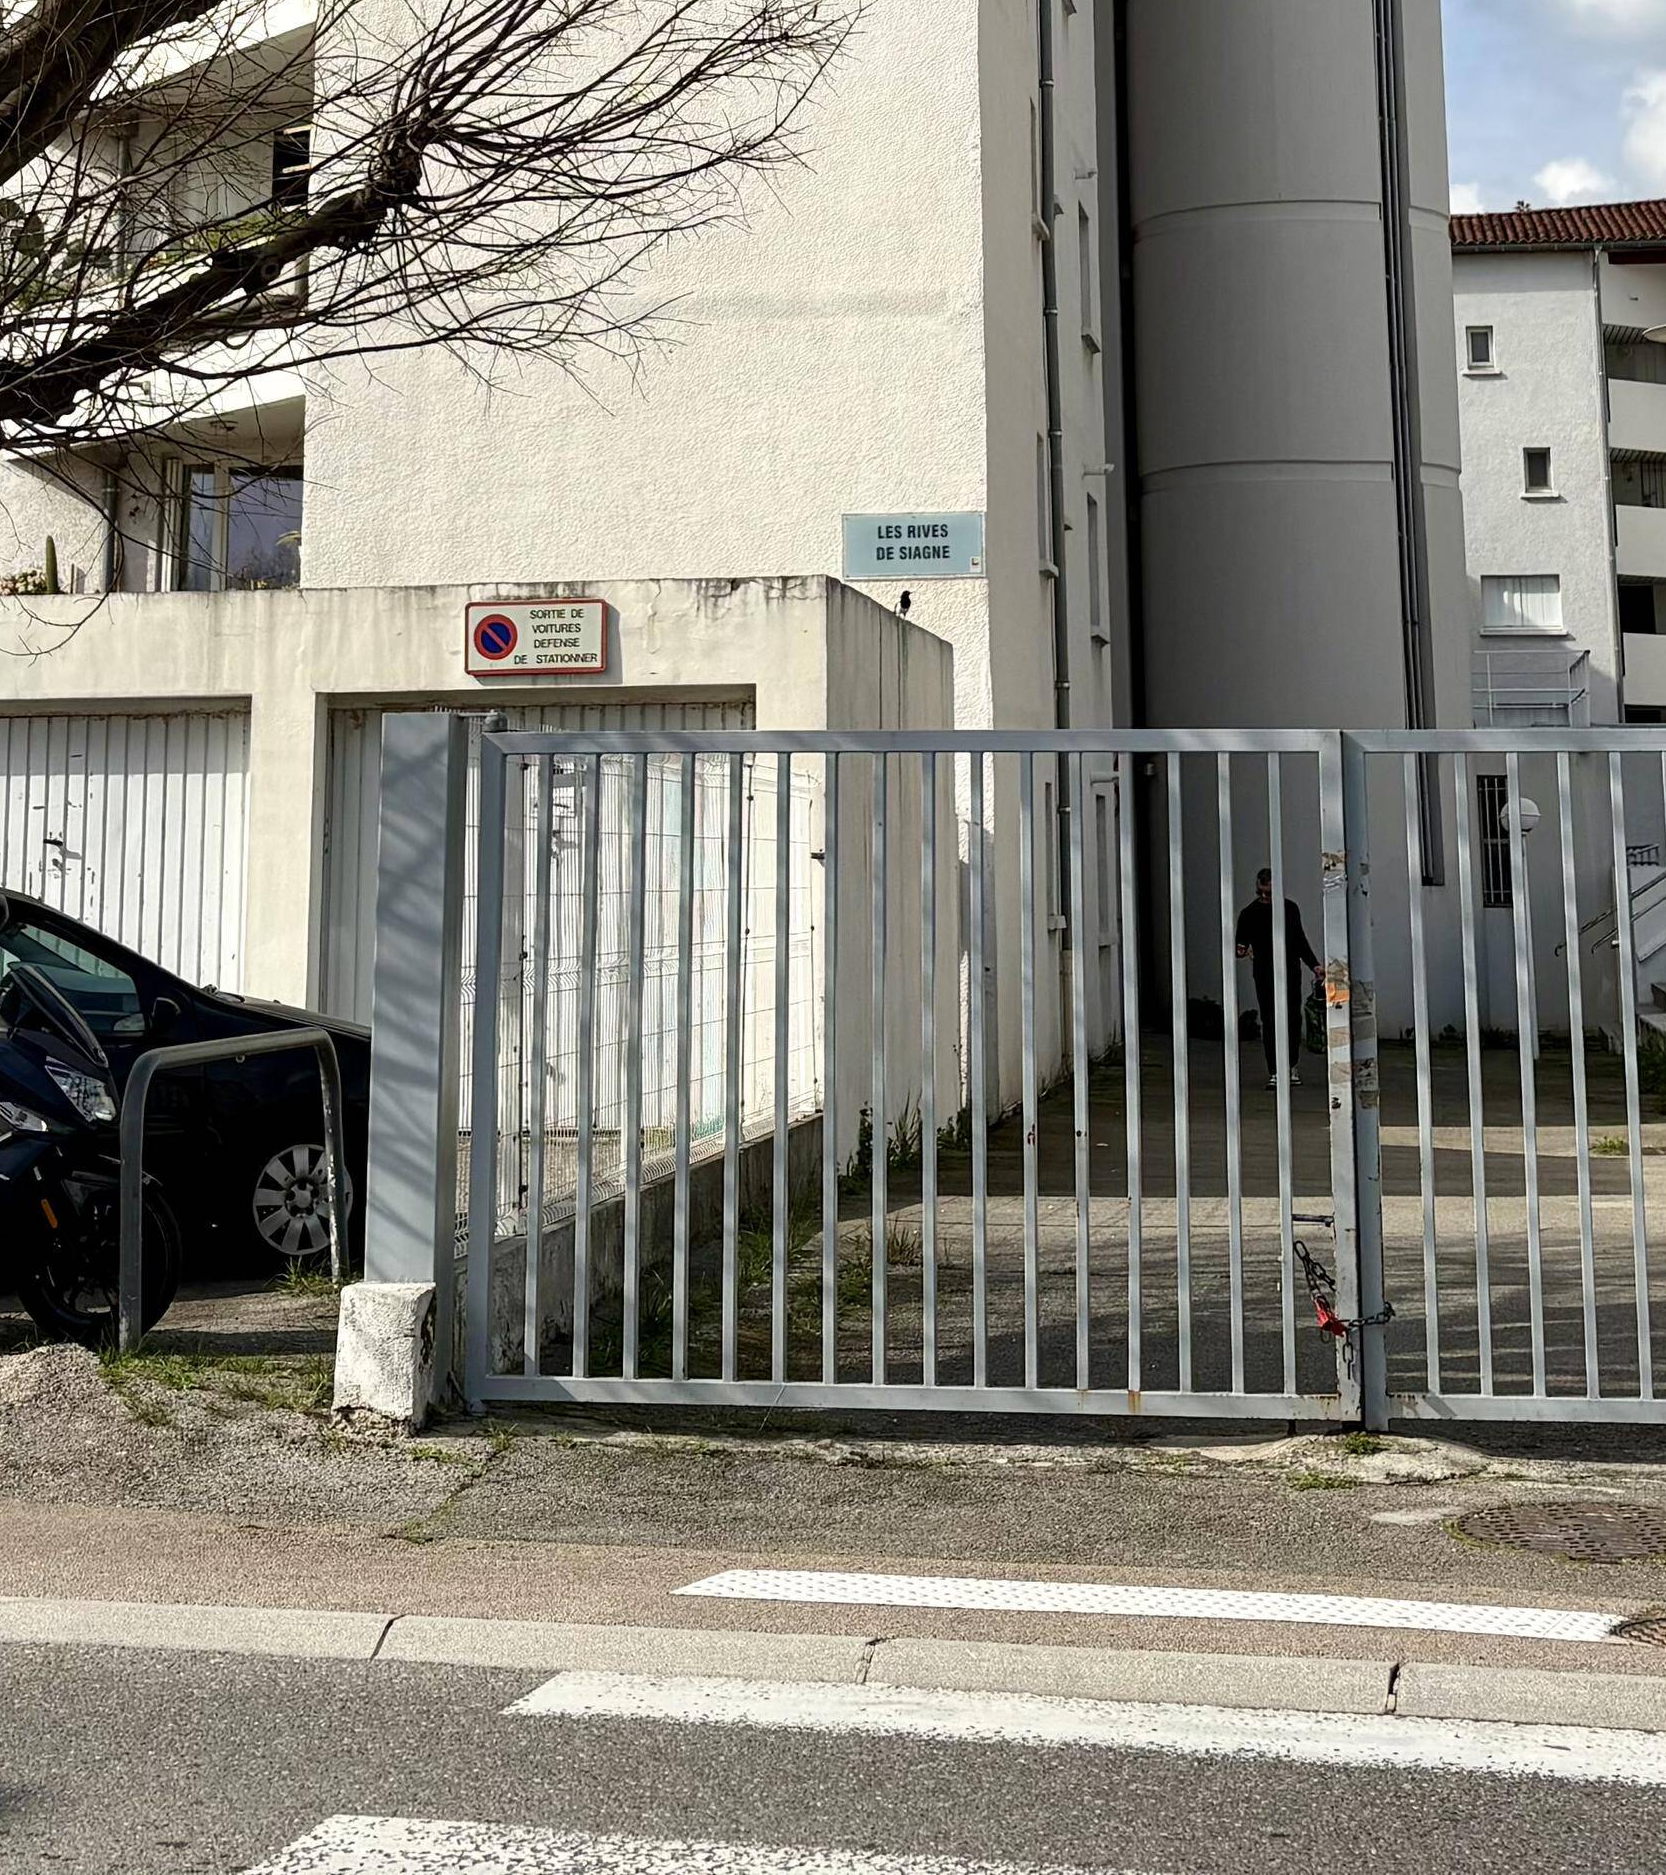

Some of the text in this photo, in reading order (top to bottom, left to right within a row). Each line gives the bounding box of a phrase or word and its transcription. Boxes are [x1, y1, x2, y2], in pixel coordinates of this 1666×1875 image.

[878, 524, 948, 539] LES RIVES
[876, 545, 950, 561] DE SIAGNE
[529, 608, 585, 619] SORTIE DE
[531, 623, 581, 634] VOITURES
[534, 637, 580, 649] DEFENSE
[514, 653, 598, 665] DE STATIONNER
